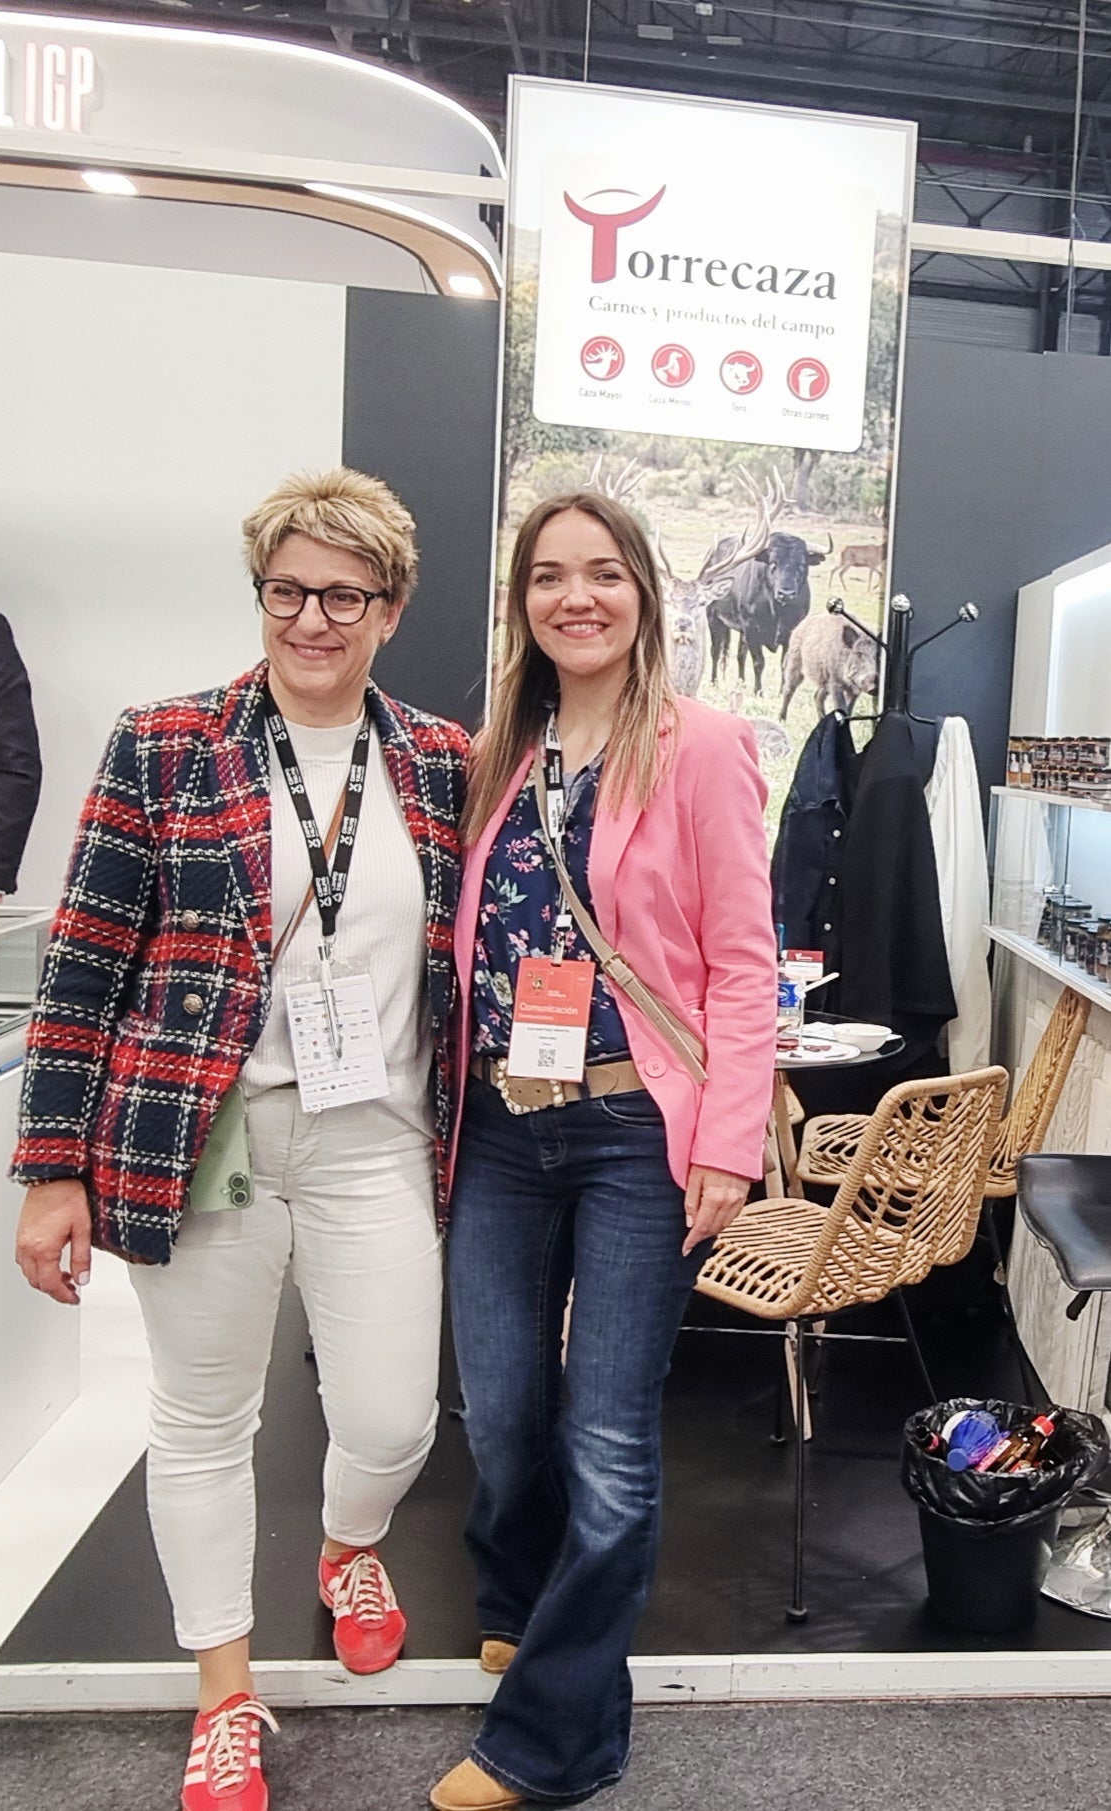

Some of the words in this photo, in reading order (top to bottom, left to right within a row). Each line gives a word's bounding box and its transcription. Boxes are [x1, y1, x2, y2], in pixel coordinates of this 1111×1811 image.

[24, 41, 95, 133] IGP
[563, 184, 837, 300] Torrecaza
[588, 294, 647, 316] Carnes
[652, 306, 661, 321] y
[666, 306, 747, 327] productos
[752, 313, 776, 331] del
[781, 321, 835, 339] campo
